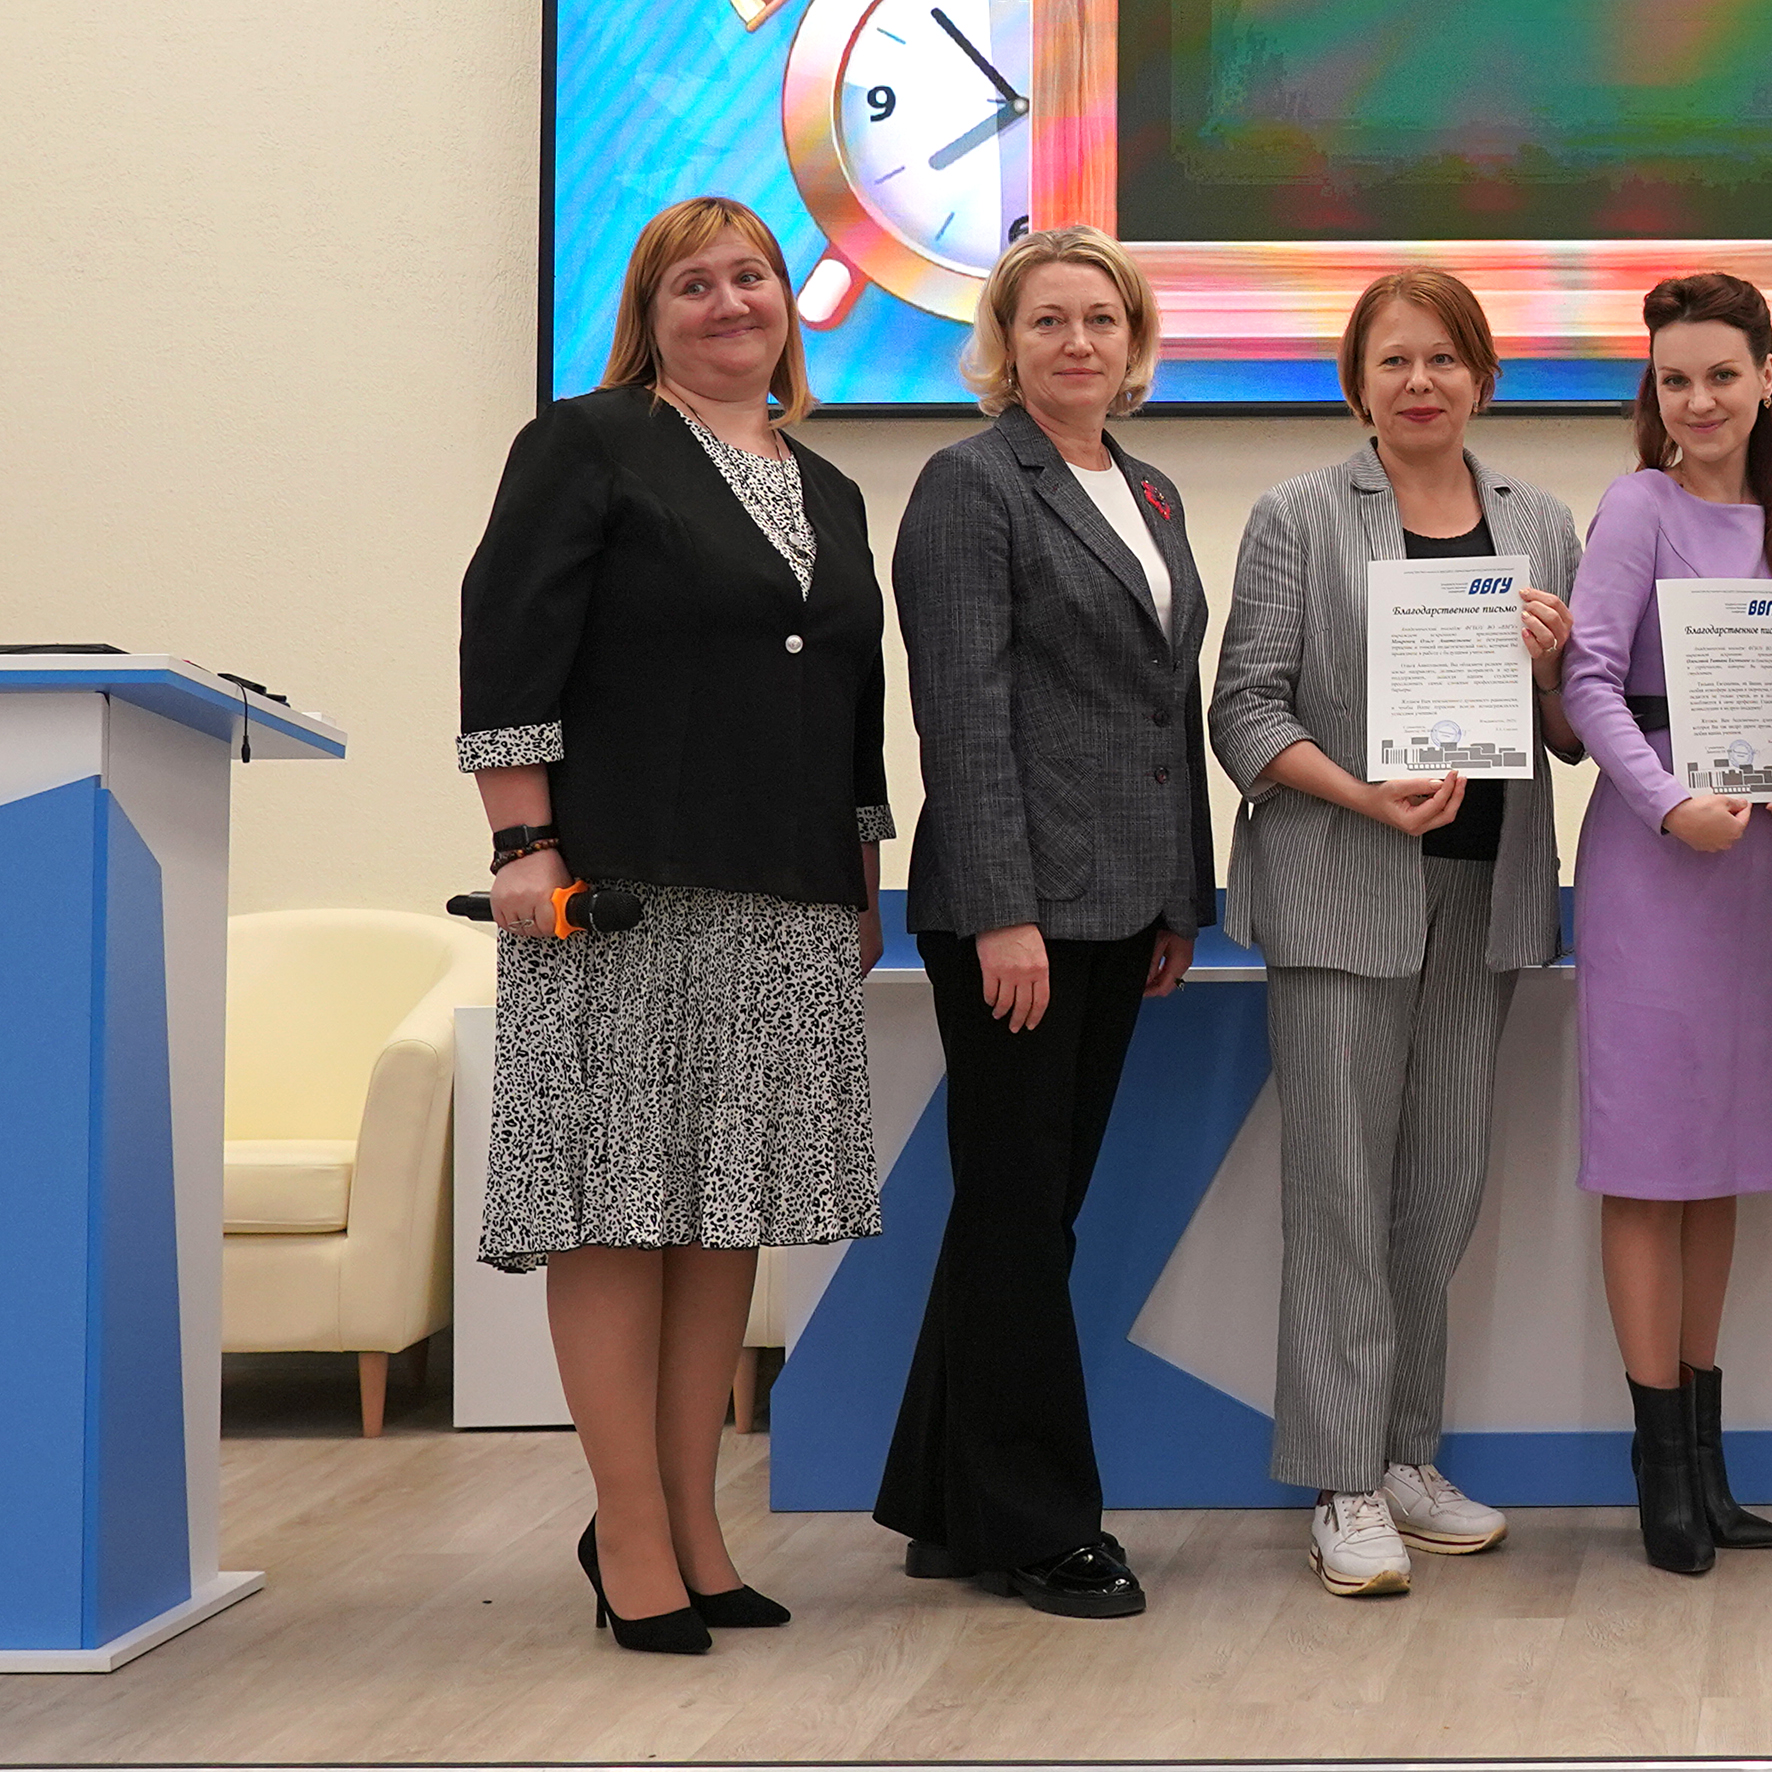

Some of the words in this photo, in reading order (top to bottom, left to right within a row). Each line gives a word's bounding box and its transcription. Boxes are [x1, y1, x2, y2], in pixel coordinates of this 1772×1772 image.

[866, 85, 898, 122] 9
[1468, 577, 1513, 595] ВВГУ
[1392, 605, 1480, 617] Благодарственное
[1482, 604, 1518, 614] письмо
